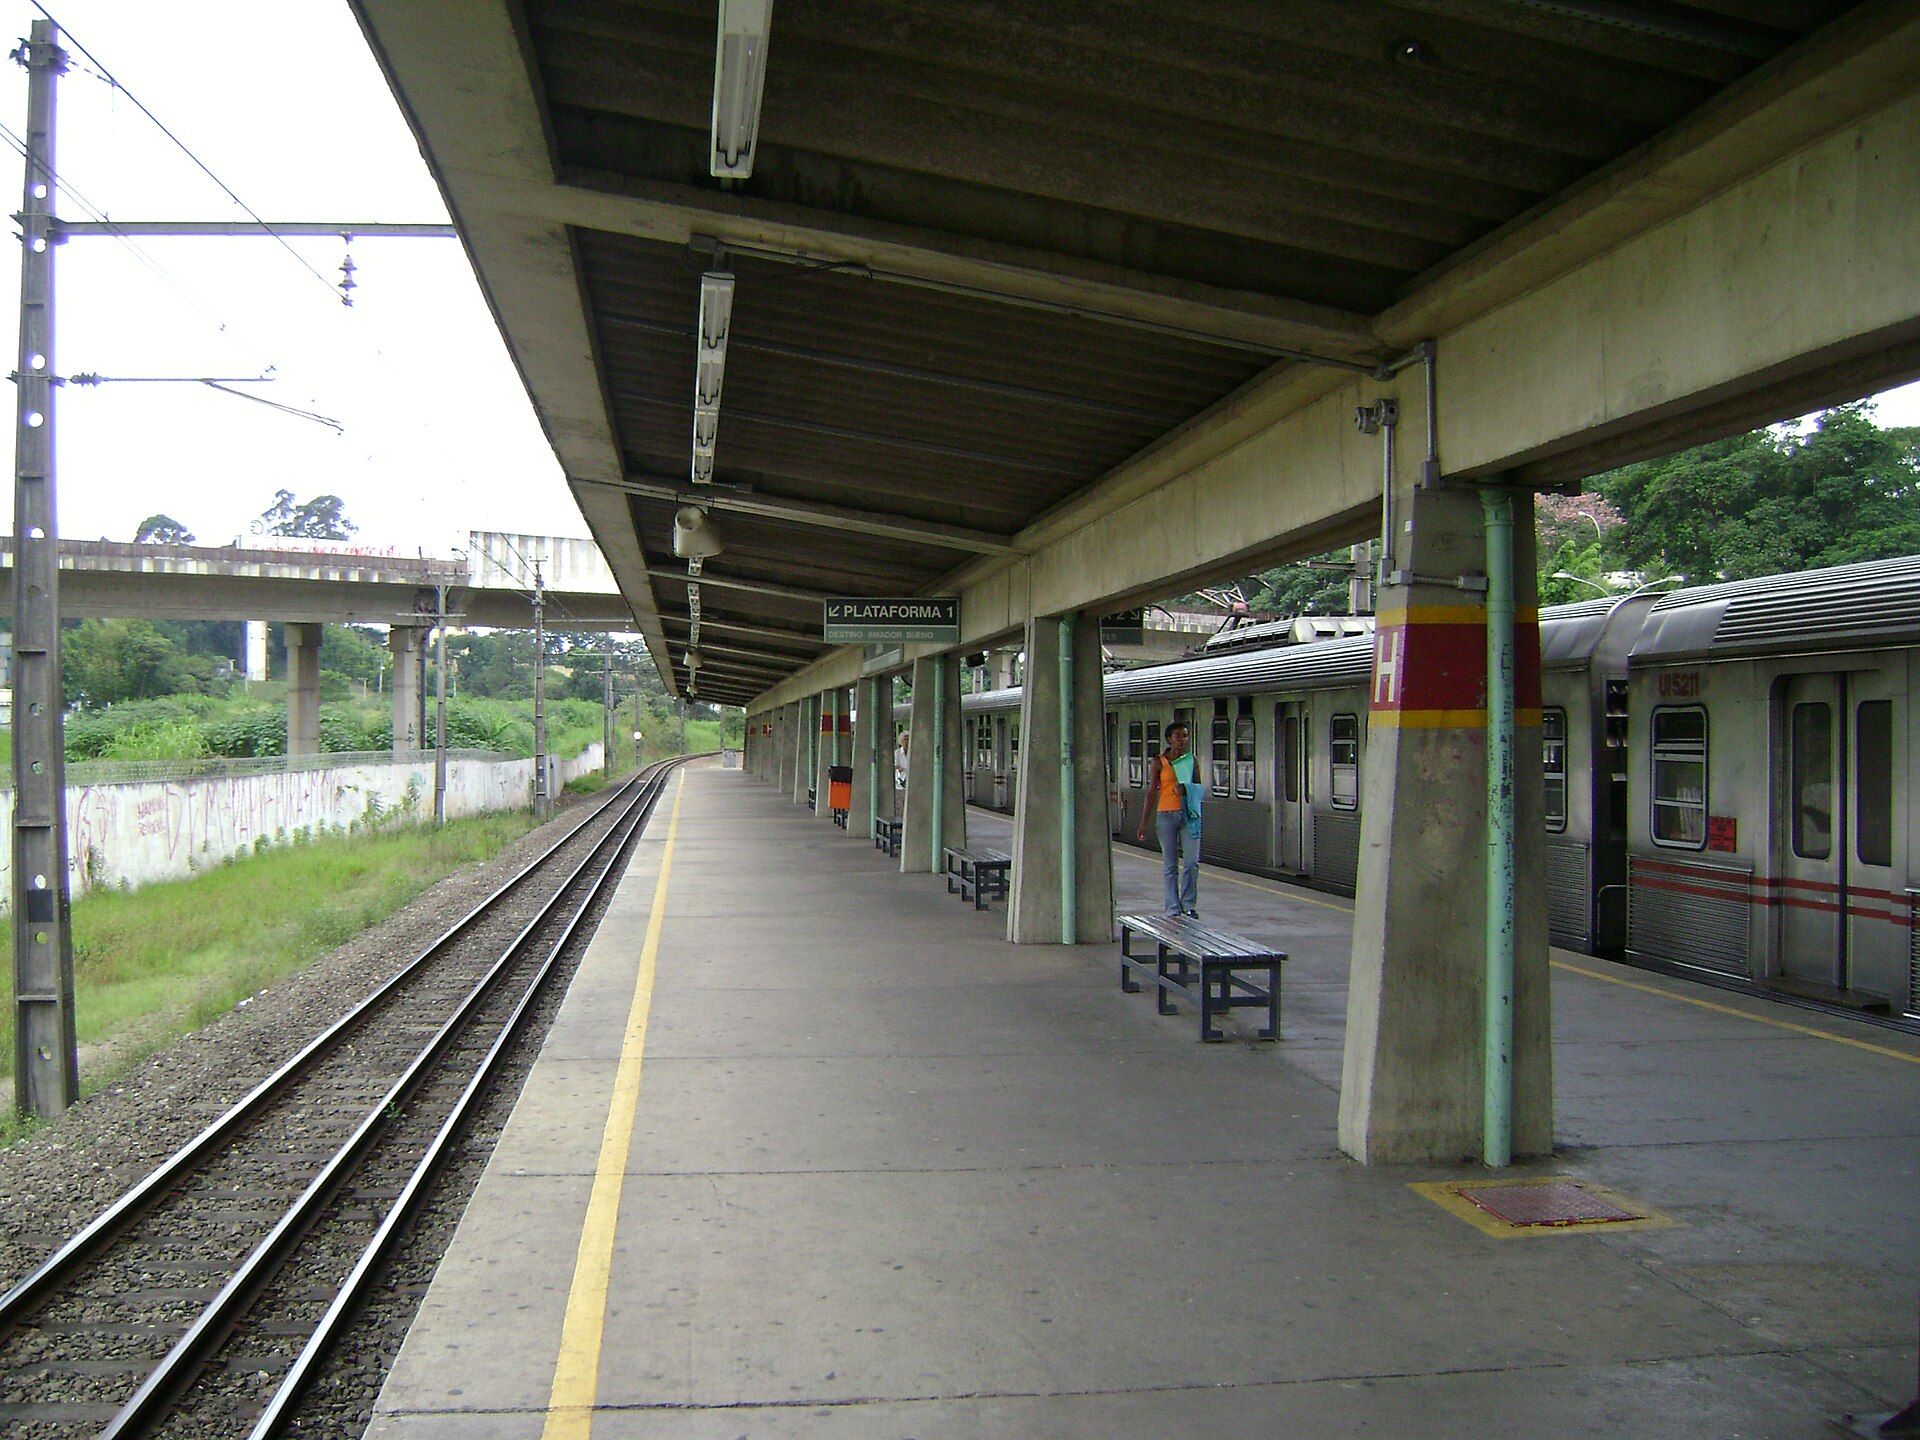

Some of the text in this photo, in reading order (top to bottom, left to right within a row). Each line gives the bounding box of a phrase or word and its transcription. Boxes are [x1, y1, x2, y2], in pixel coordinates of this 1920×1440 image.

[843, 605, 953, 618] PLATAFORMA 1
[828, 631, 934, 639] DESTINO AMADOR BUENO
[1374, 631, 1398, 703] H
